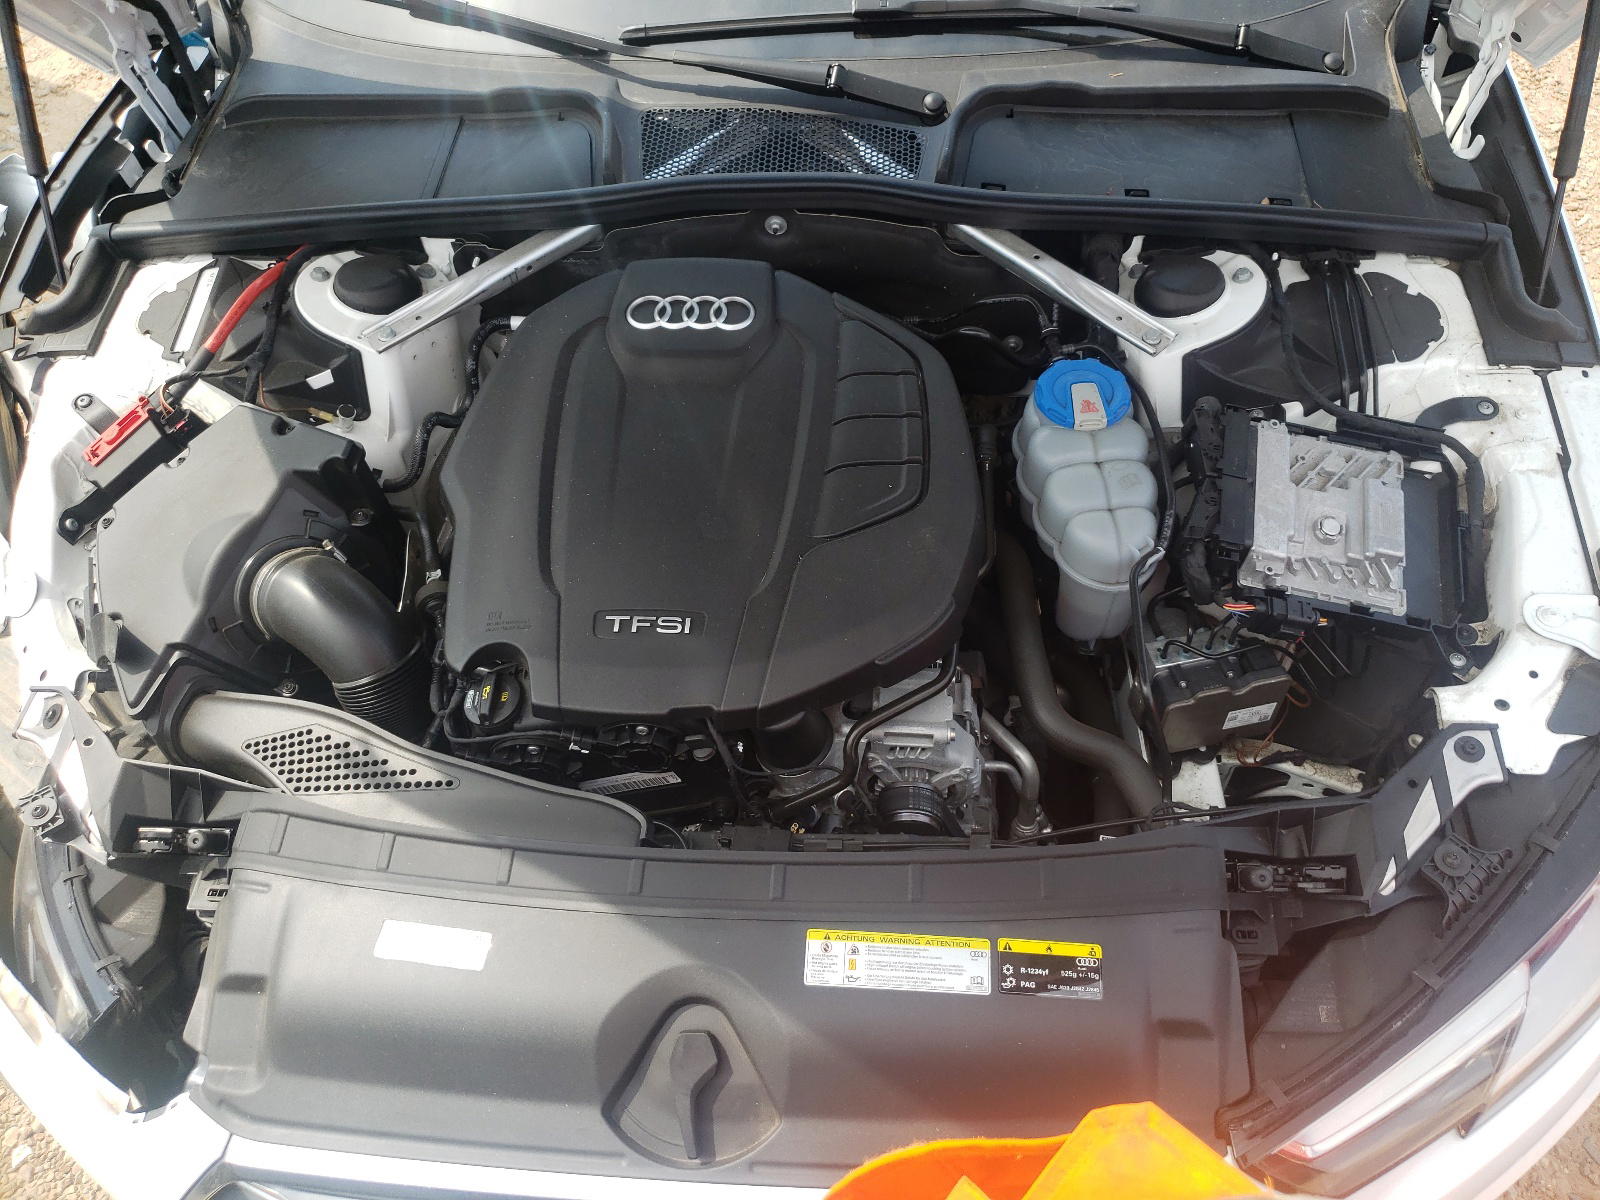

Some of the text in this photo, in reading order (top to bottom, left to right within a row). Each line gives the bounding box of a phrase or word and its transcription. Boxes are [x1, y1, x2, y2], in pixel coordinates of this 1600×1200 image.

[605, 615, 691, 634] TFSI
[834, 934, 971, 948] ACHTUNG WARNING ATTENTION
[1020, 980, 1036, 988] PAG
